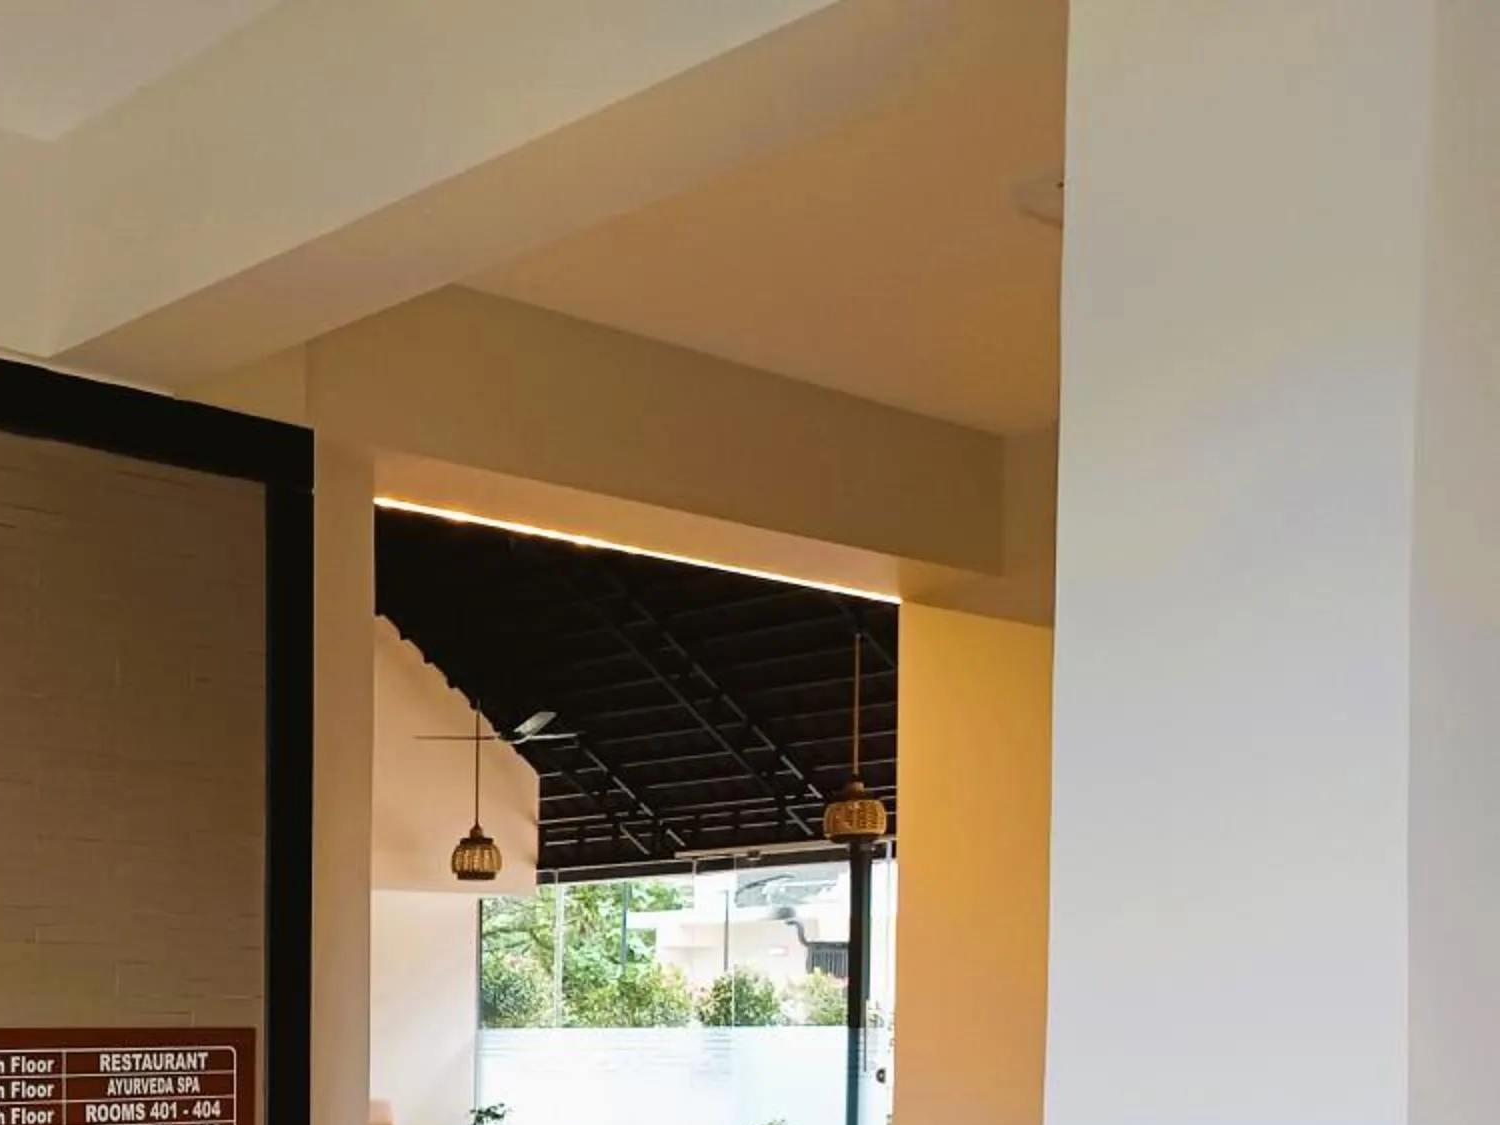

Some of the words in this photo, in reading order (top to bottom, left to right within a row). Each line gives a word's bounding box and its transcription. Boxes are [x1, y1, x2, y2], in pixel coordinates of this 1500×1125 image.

[10, 1055, 55, 1073] Floor
[100, 1052, 209, 1072] RESTAURANT
[10, 1081, 55, 1098] Floor
[107, 1077, 174, 1097] AYURVEDA
[177, 1076, 201, 1094] SPA
[10, 1107, 55, 1125] Floor
[85, 1102, 146, 1123] ROOMS
[149, 1101, 178, 1120] 401
[192, 1100, 221, 1118] 404
